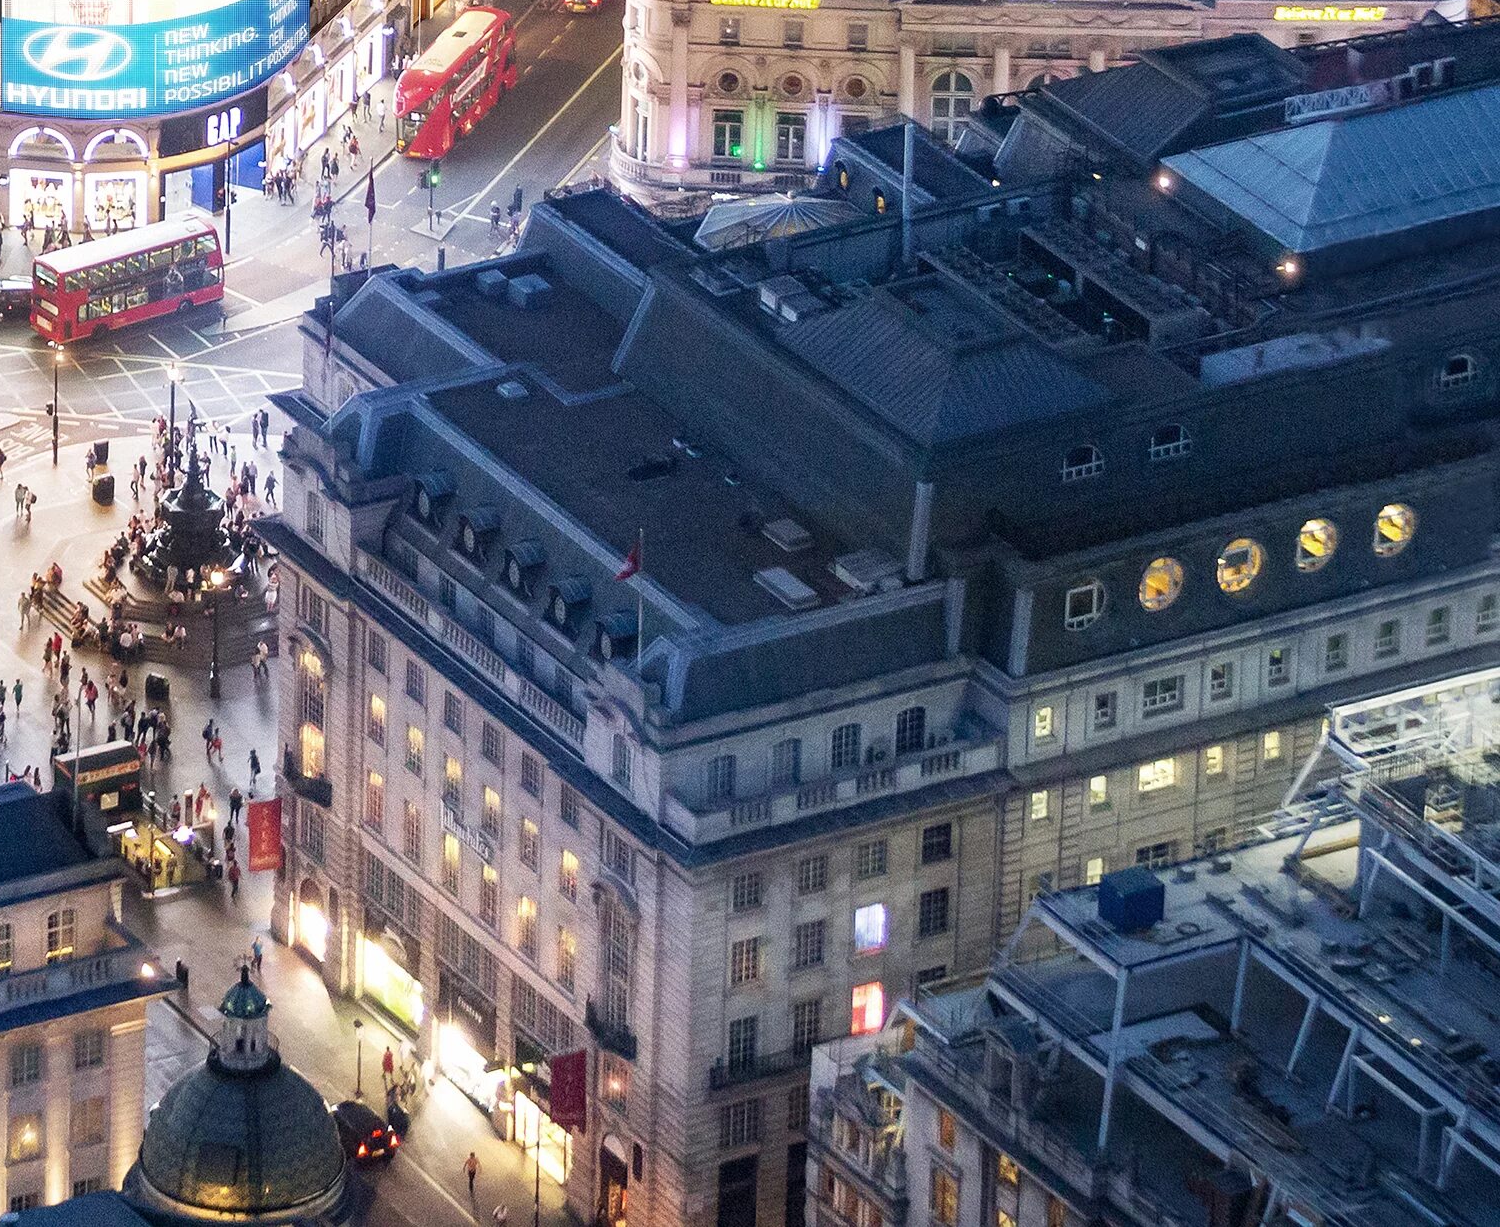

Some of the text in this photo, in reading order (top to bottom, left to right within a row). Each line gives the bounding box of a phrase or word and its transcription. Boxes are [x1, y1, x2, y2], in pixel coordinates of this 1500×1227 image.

[165, 22, 211, 46] NEW
[165, 26, 260, 67] THINKING.
[165, 62, 211, 86] NEW
[6, 82, 147, 109] HYUNDAI
[206, 106, 243, 147] GAP
